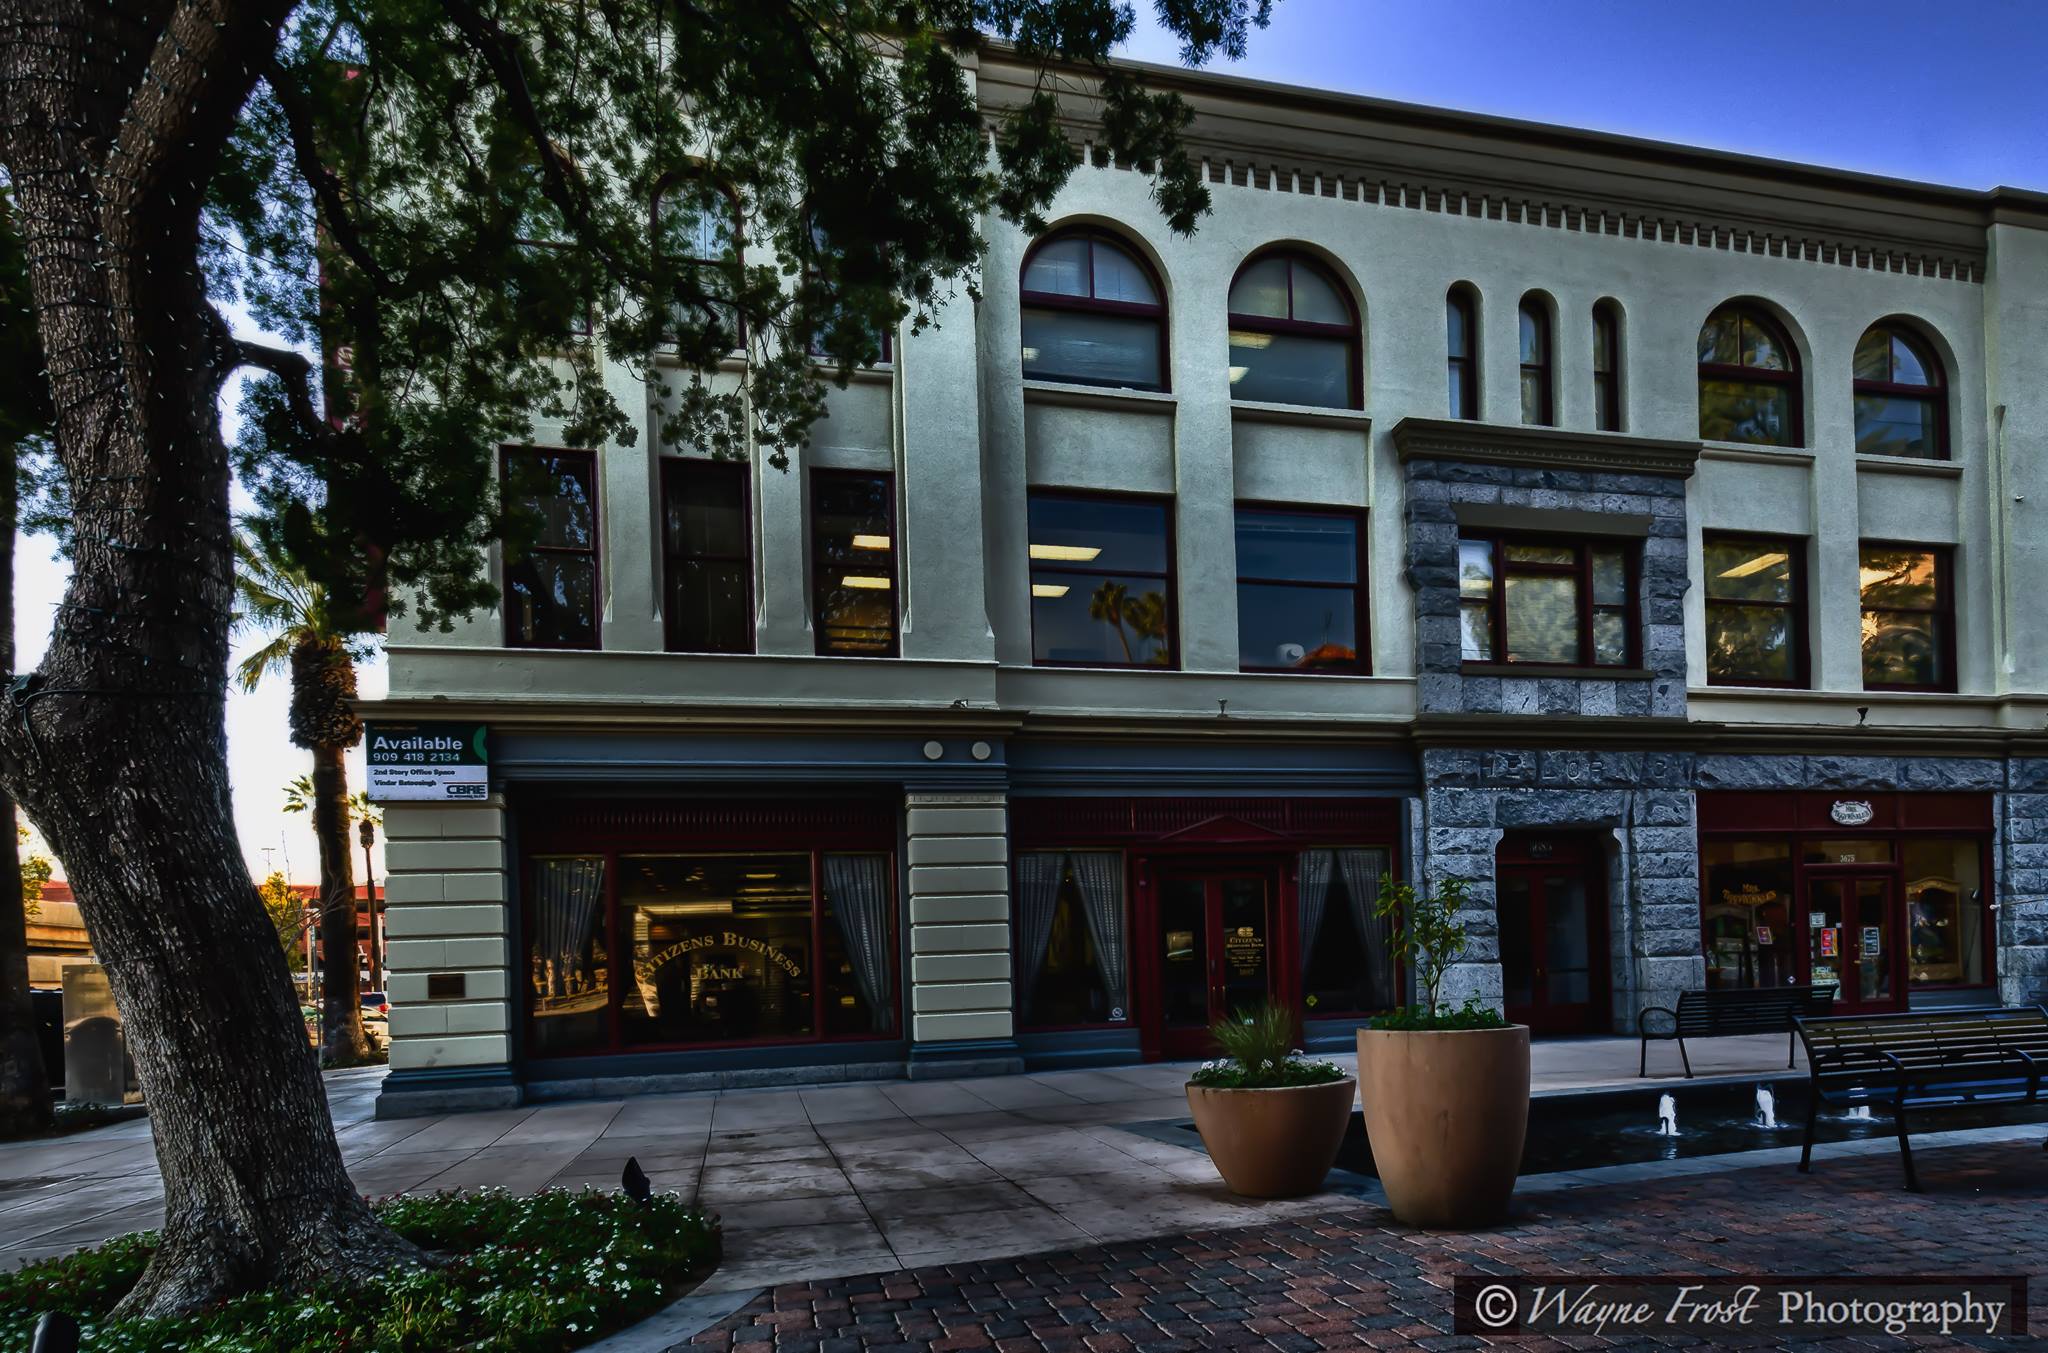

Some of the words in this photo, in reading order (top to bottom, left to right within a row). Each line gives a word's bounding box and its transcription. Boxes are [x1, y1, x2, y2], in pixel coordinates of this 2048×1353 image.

[373, 736, 463, 751] Available
[372, 753, 398, 762] 909
[403, 753, 425, 762] 418
[429, 753, 461, 762] 2134
[389, 769, 409, 777] Story
[410, 768, 433, 776] Office
[433, 768, 456, 777] Space
[446, 785, 486, 795] CBRE
[635, 934, 716, 978] CITIZENS
[721, 931, 802, 978] BUSINESS
[696, 967, 746, 980] BANK
